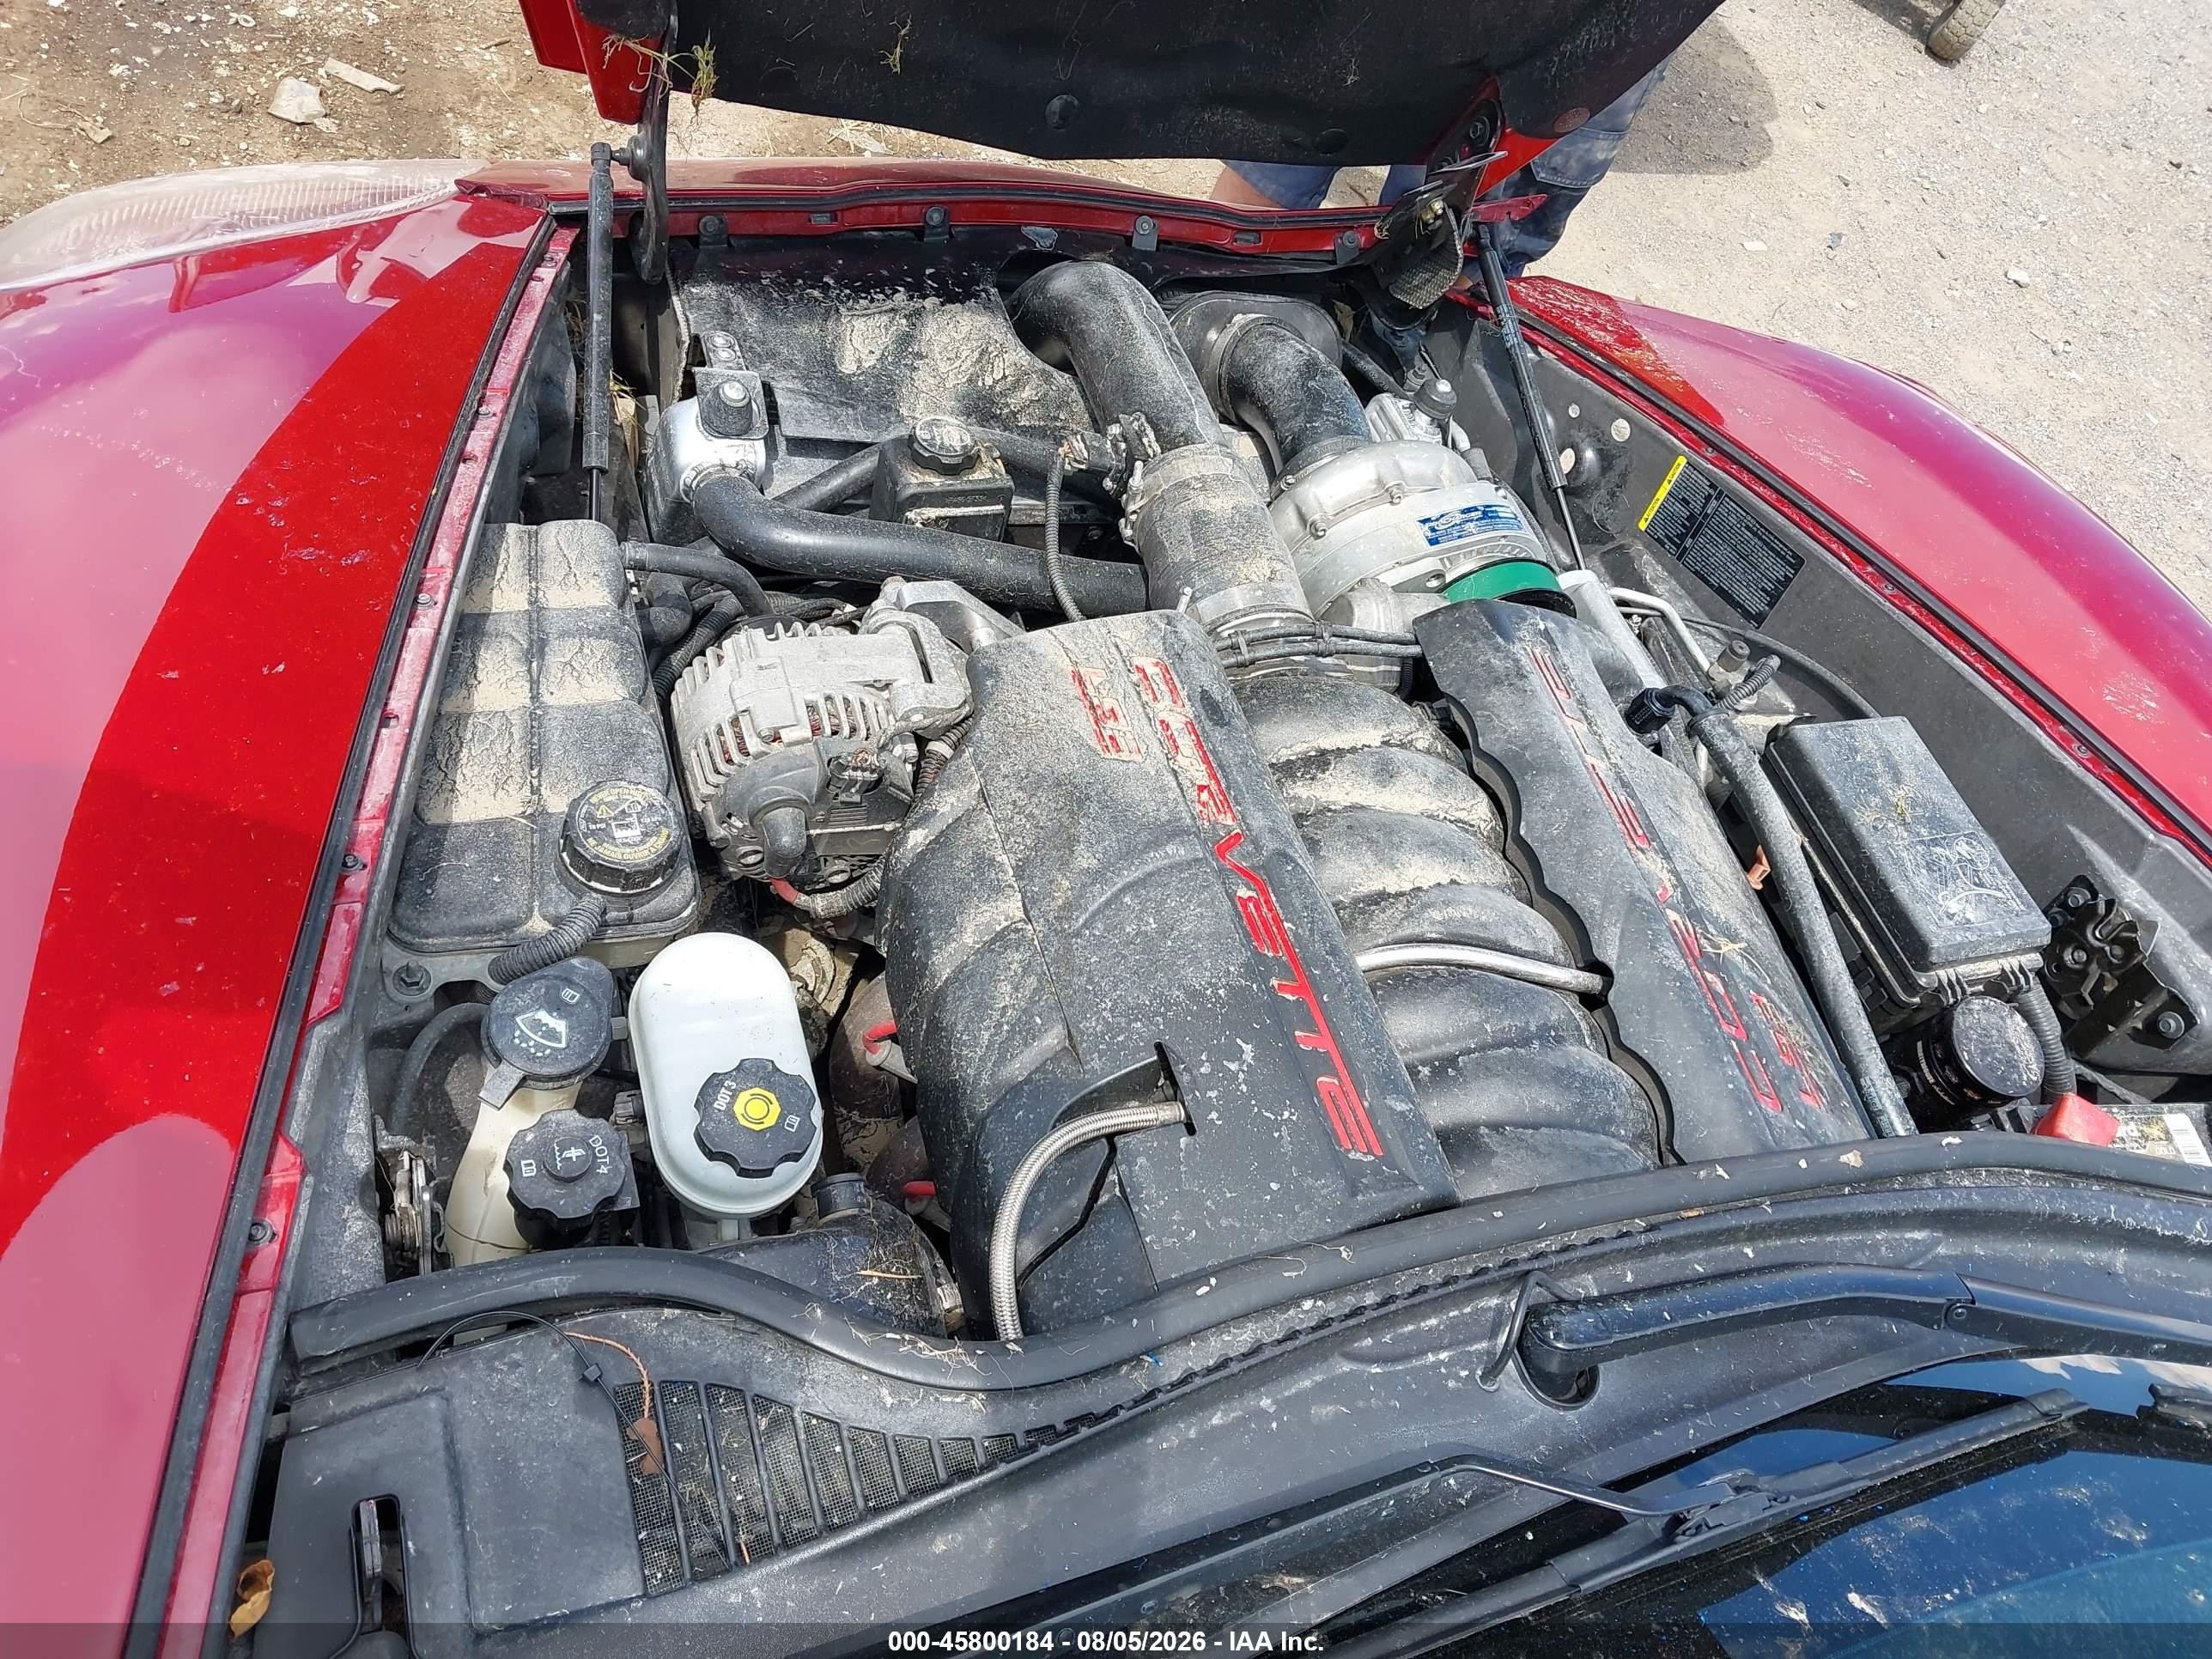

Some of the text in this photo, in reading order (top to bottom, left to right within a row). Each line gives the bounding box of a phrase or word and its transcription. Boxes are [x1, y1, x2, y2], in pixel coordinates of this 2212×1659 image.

[1131, 656, 1385, 1158] CORVETTE
[713, 1080, 737, 1111] DOT 3
